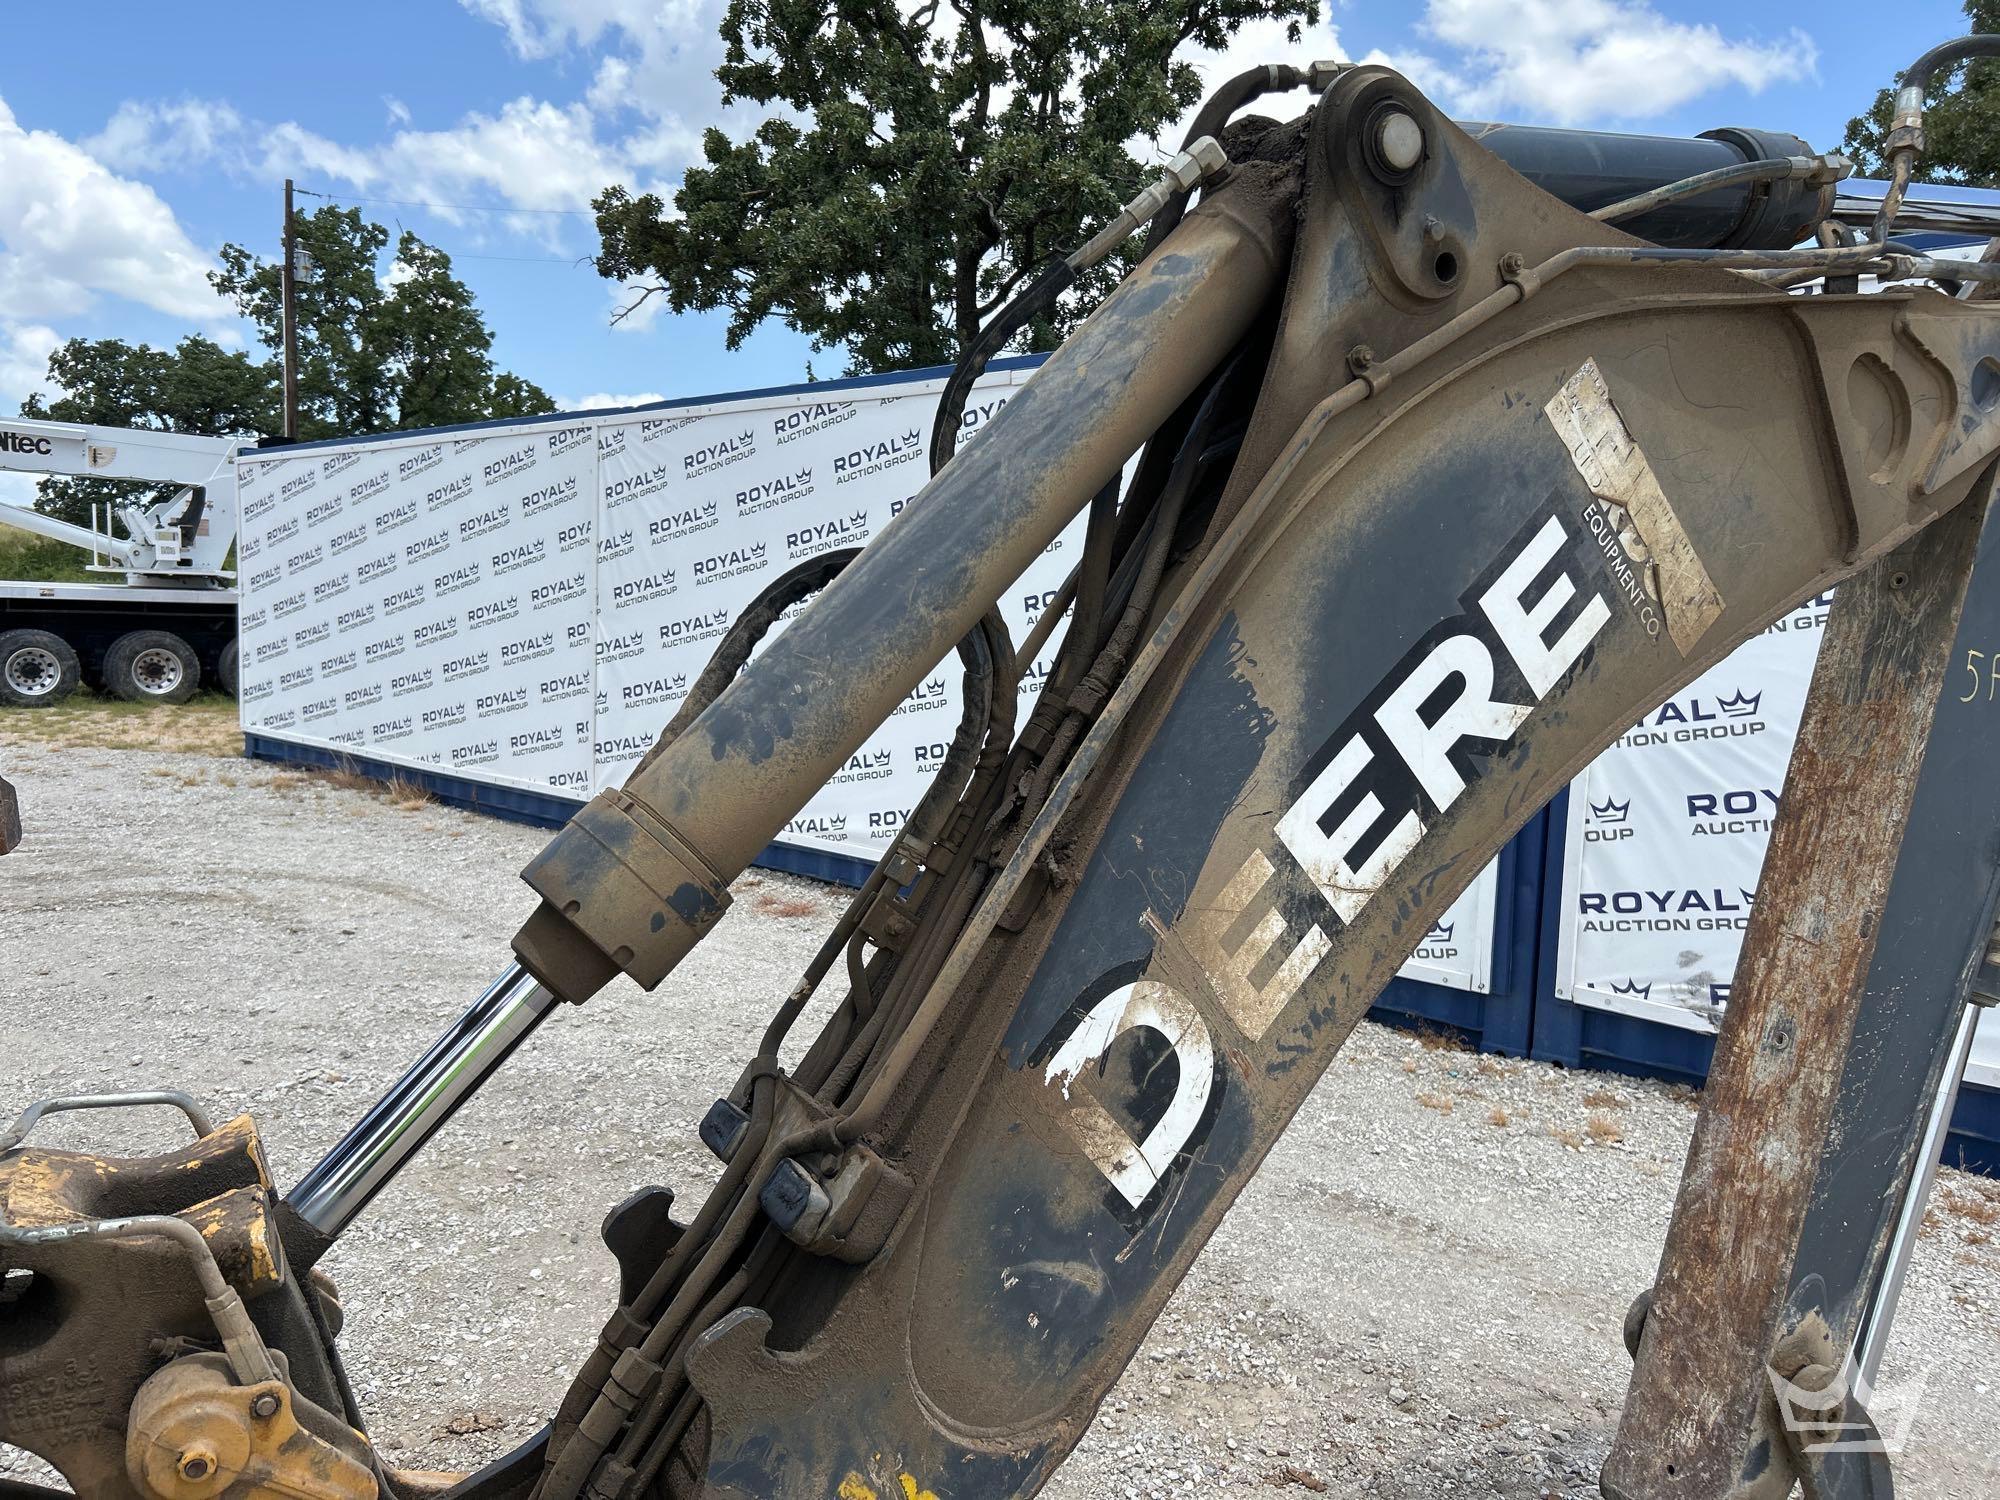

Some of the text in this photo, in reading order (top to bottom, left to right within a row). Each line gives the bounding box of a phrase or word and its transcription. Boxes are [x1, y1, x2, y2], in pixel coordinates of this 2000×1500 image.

[774, 403, 837, 435] ROYAL
[963, 398, 1006, 427] OYA
[643, 423, 678, 443] AUCTION
[777, 409, 857, 446] AUCTION GROUP
[323, 452, 352, 472] ROYAL
[400, 450, 433, 474] ROYAL
[601, 445, 626, 461] GROUP
[684, 438, 739, 469] ROYAL
[833, 438, 902, 473] ROYAL
[401, 457, 442, 482] AUCTION GROUP
[484, 452, 524, 478] ROYAL
[486, 460, 536, 486] AUCTION GROUP
[686, 448, 756, 480] AUCTION GROUP
[836, 449, 922, 485] AUCTION GROUP
[282, 476, 308, 495] ROYAL
[351, 479, 380, 498] ROYAL
[428, 480, 462, 504] ROYAL
[605, 473, 653, 500] ROYAL
[607, 481, 668, 510] AUCTION GROUP
[736, 476, 796, 507] ROYAL
[429, 488, 473, 512] AUCTION GROUP
[522, 483, 565, 509] ROYAL
[524, 492, 577, 518] AUCTION GROUP
[738, 486, 815, 518] AUCTION GROUP
[244, 497, 269, 516] ROYAL
[307, 500, 335, 521] ROYAL
[376, 506, 408, 527] ROYAL
[267, 521, 292, 541] ROYAL
[460, 510, 498, 534] ROYAL
[462, 519, 510, 542] AUCTION GROUP
[650, 508, 702, 536] ROYAL
[652, 518, 718, 546] AUCTION GROUP
[330, 530, 358, 549] ROYAL
[558, 521, 591, 544] ROYA
[787, 518, 850, 549] ROYAL
[407, 535, 440, 557] ROYAL
[598, 537, 620, 553] YAL
[610, 546, 634, 560] GROUP
[789, 530, 869, 560] AUCTION GROUP
[1583, 503, 1645, 606] EQUIPMENT
[288, 550, 315, 569] ROYAL
[492, 545, 533, 568] ROYAL
[494, 554, 545, 576] AUCTION GROUP
[694, 549, 750, 576] ROYAL
[358, 557, 388, 577] ROYAL
[696, 560, 768, 586] AUCTION GROUP
[251, 569, 274, 586] ROYAL
[314, 577, 342, 596] ROYAL
[435, 568, 470, 590] ROYAL
[436, 577, 480, 597] AUCTION GROUP
[531, 578, 574, 602] ROYAL
[614, 576, 662, 600] ROYAL
[615, 586, 677, 609] AUCTION GROUP
[273, 596, 297, 613] ROYAL
[384, 589, 415, 609] ROYAL
[533, 589, 587, 611] AUCTION GROUP
[242, 612, 260, 627] OYAL
[338, 608, 366, 626] ROYAL
[468, 600, 508, 622] ROYAL
[470, 610, 519, 630] AUCTION GROUP
[296, 626, 322, 642] ROYAL
[414, 620, 448, 640] ROYAL
[660, 614, 713, 639] ROYAL
[365, 638, 396, 656] ROYAL
[416, 630, 457, 648] AUCTION GROUP
[501, 637, 542, 658] ROYAL
[596, 637, 631, 655] OYAL
[662, 627, 729, 649] AUCTION GROUP
[257, 642, 282, 656] ROYAL
[503, 647, 554, 667] AUCTION GROUP
[596, 648, 644, 666] CTION GROUP
[321, 655, 349, 671] ROYAL
[443, 655, 478, 674] ROYAL
[280, 669, 306, 685] ROYAL
[392, 672, 424, 690] ROYAL
[445, 665, 489, 683] AUCTION GROUP
[540, 674, 583, 694] ROYAL
[243, 683, 266, 697] ROYAL
[345, 687, 373, 703] ROYAL
[542, 687, 589, 704] AUCTION GRO
[623, 679, 672, 699] ROYAL
[303, 700, 329, 716] ROYAL
[477, 690, 517, 709] ROYAL
[625, 690, 688, 709] AUCTION GROUP
[909, 699, 947, 713] GROUP
[422, 706, 455, 723] ROYAL
[479, 702, 528, 718] AUCTION GROUP
[373, 720, 404, 735] ROYAL
[1614, 721, 1766, 749] TION GROUP
[510, 730, 551, 748] ROYAL
[511, 741, 563, 756] AUCTION GROUP
[595, 737, 640, 755] ROYAL
[452, 744, 487, 760] ROYAL
[454, 754, 499, 768] AUCTION GROUP
[595, 750, 646, 764] AUCTION GRO
[915, 743, 951, 762] ROY
[857, 769, 893, 781] GROUP
[917, 762, 944, 773] AUCT
[1687, 789, 1779, 817] ROY
[783, 818, 829, 833] YAL
[869, 809, 911, 827] ROY
[1691, 820, 1775, 836] AUCT
[870, 829, 901, 839] AUCT
[1585, 827, 1634, 842] OUP
[1045, 514, 1612, 1210] DEERE
[1579, 888, 1740, 915] ROYAL
[1583, 918, 1748, 932] AUCTION GRO
[1408, 948, 1457, 958] OUP
